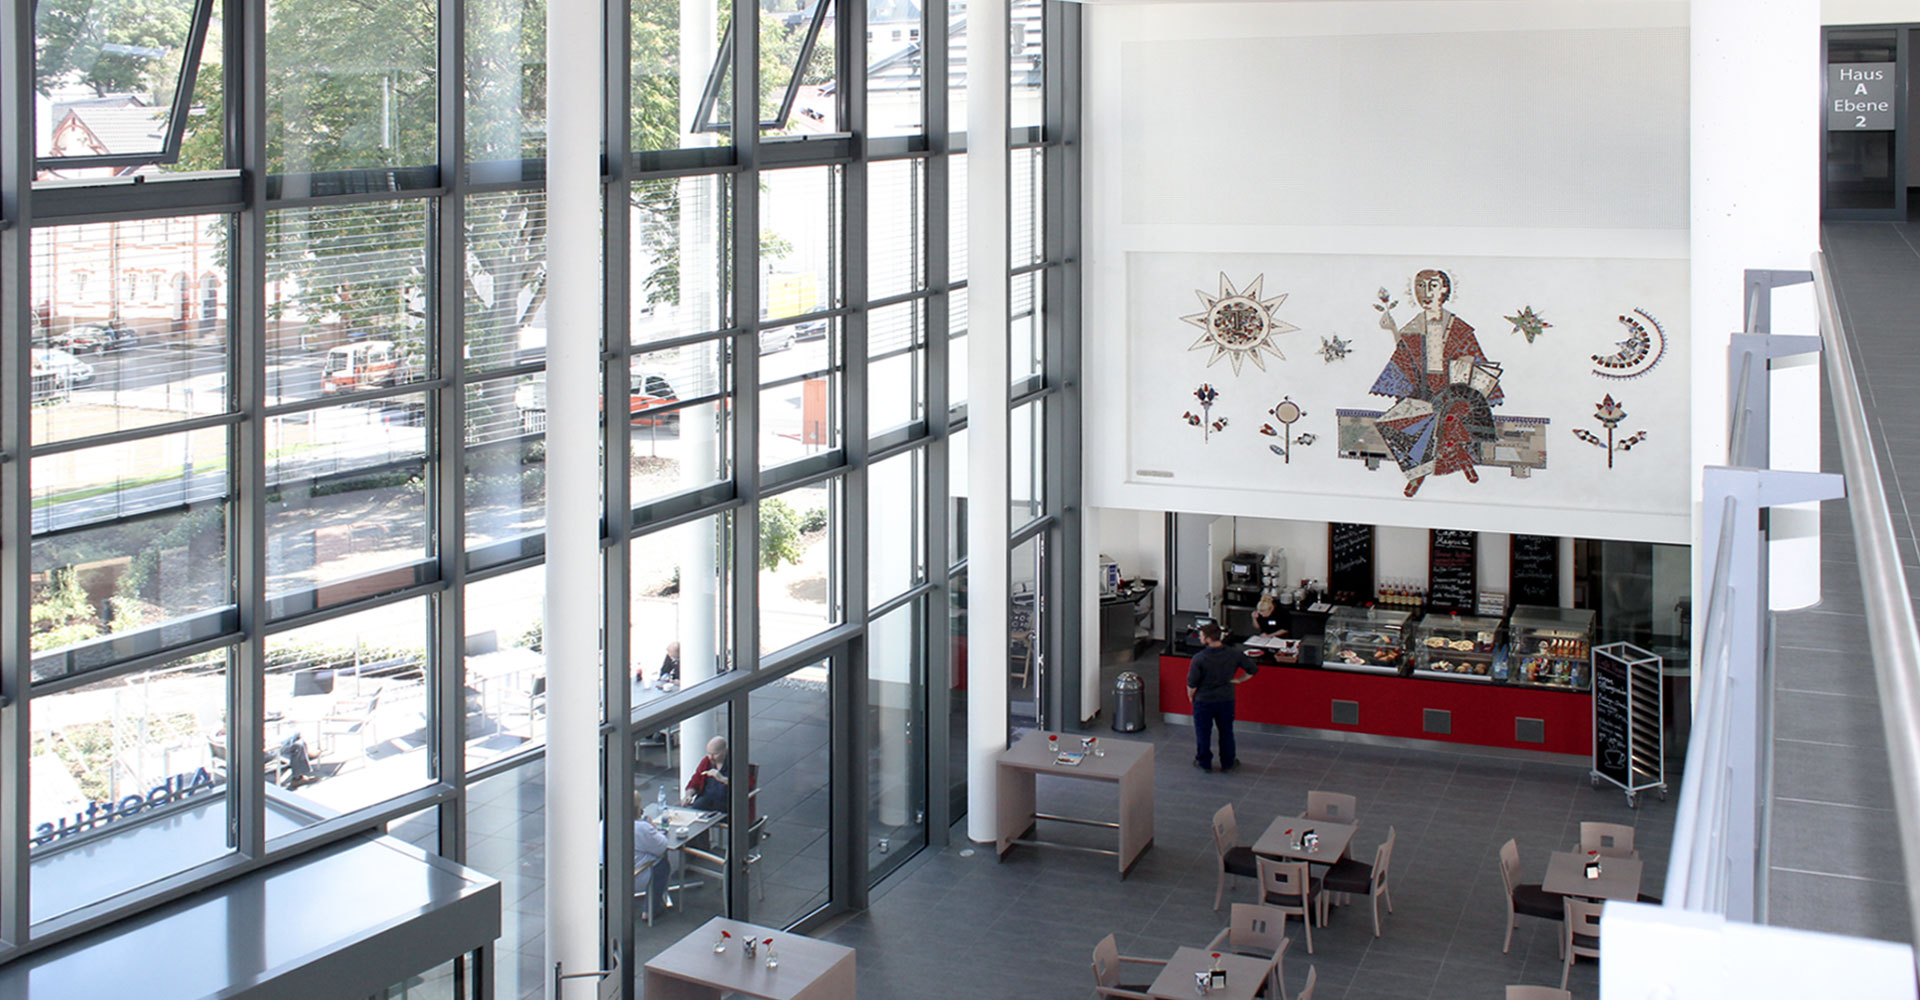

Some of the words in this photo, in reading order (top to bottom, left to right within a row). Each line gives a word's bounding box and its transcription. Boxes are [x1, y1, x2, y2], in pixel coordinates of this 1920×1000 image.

[1840, 68, 1884, 81] Haus
[1854, 83, 1868, 95] A
[1834, 99, 1889, 112] Ebene
[1855, 115, 1867, 128] 2
